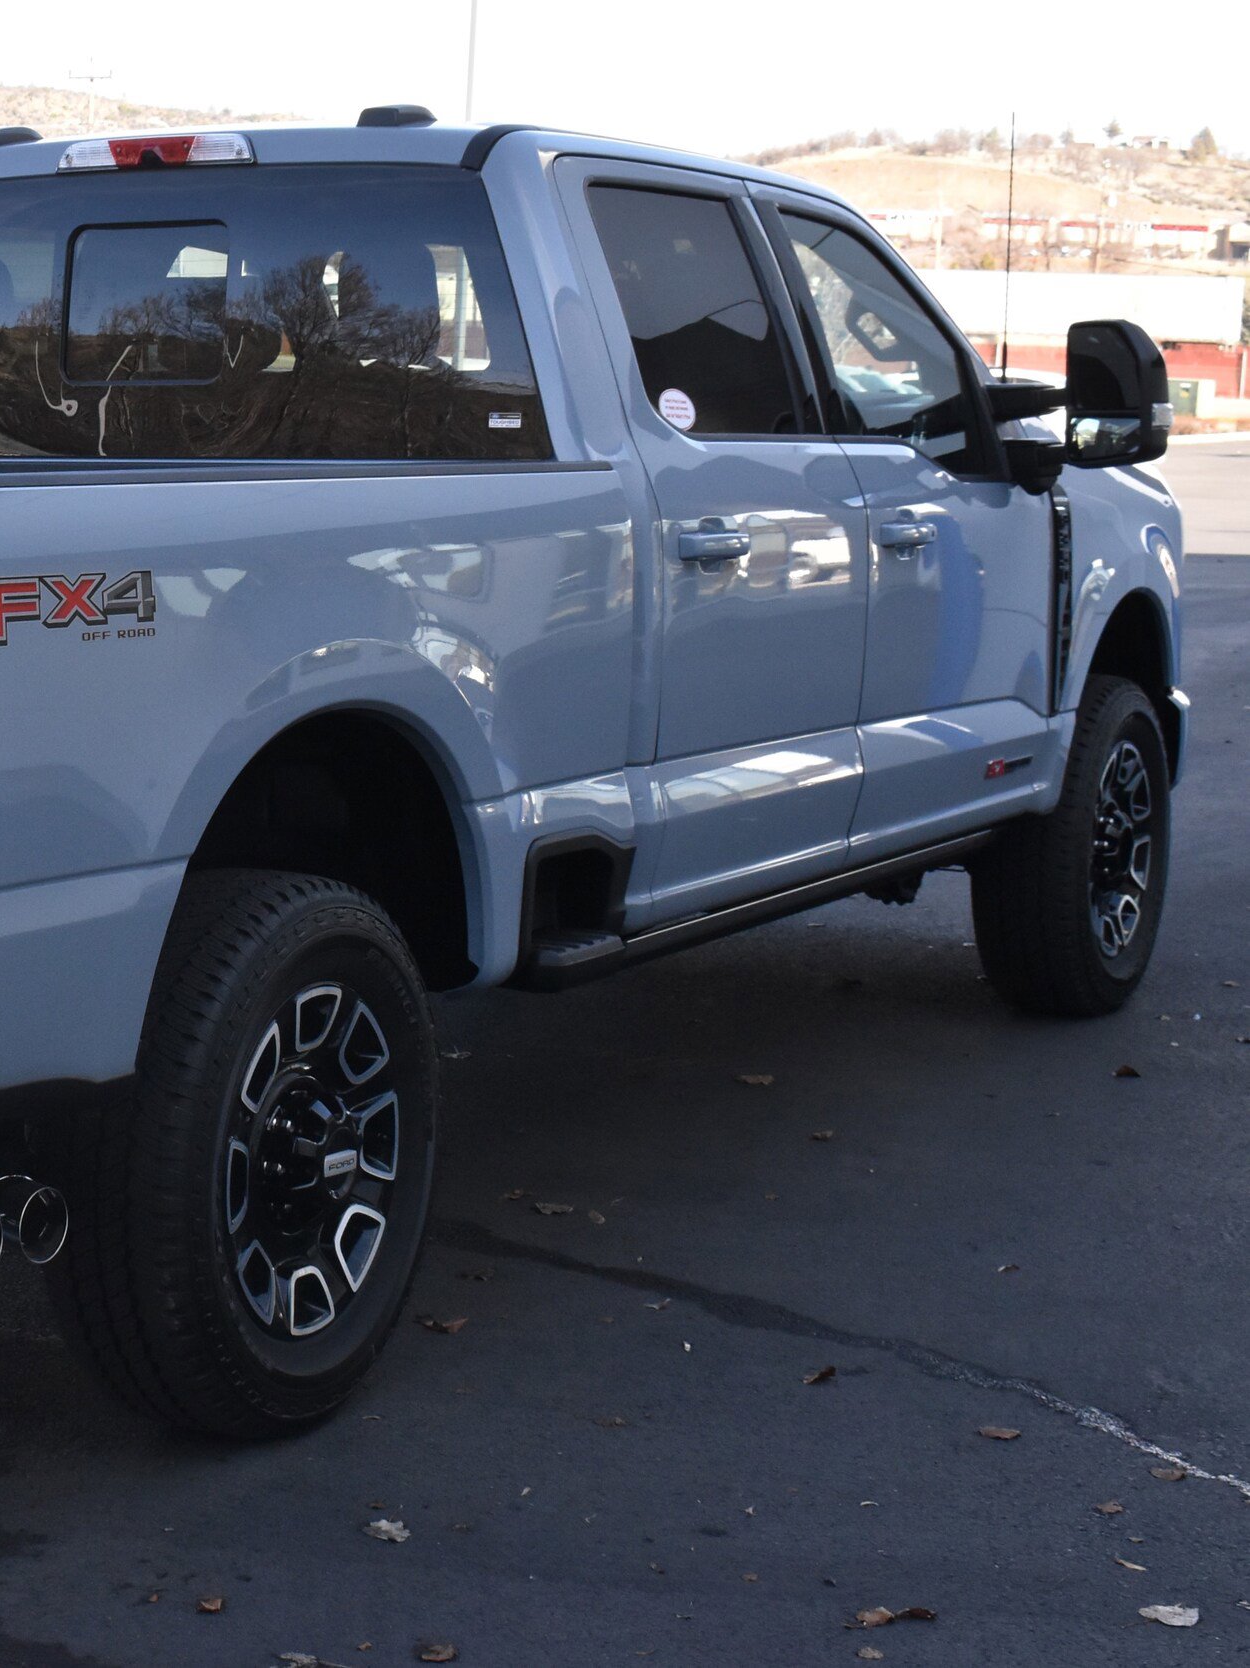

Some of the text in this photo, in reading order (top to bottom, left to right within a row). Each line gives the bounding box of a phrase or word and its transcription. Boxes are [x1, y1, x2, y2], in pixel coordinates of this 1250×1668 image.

[81, 627, 156, 642] OFF ROAD
[328, 1158, 354, 1171] FORD
